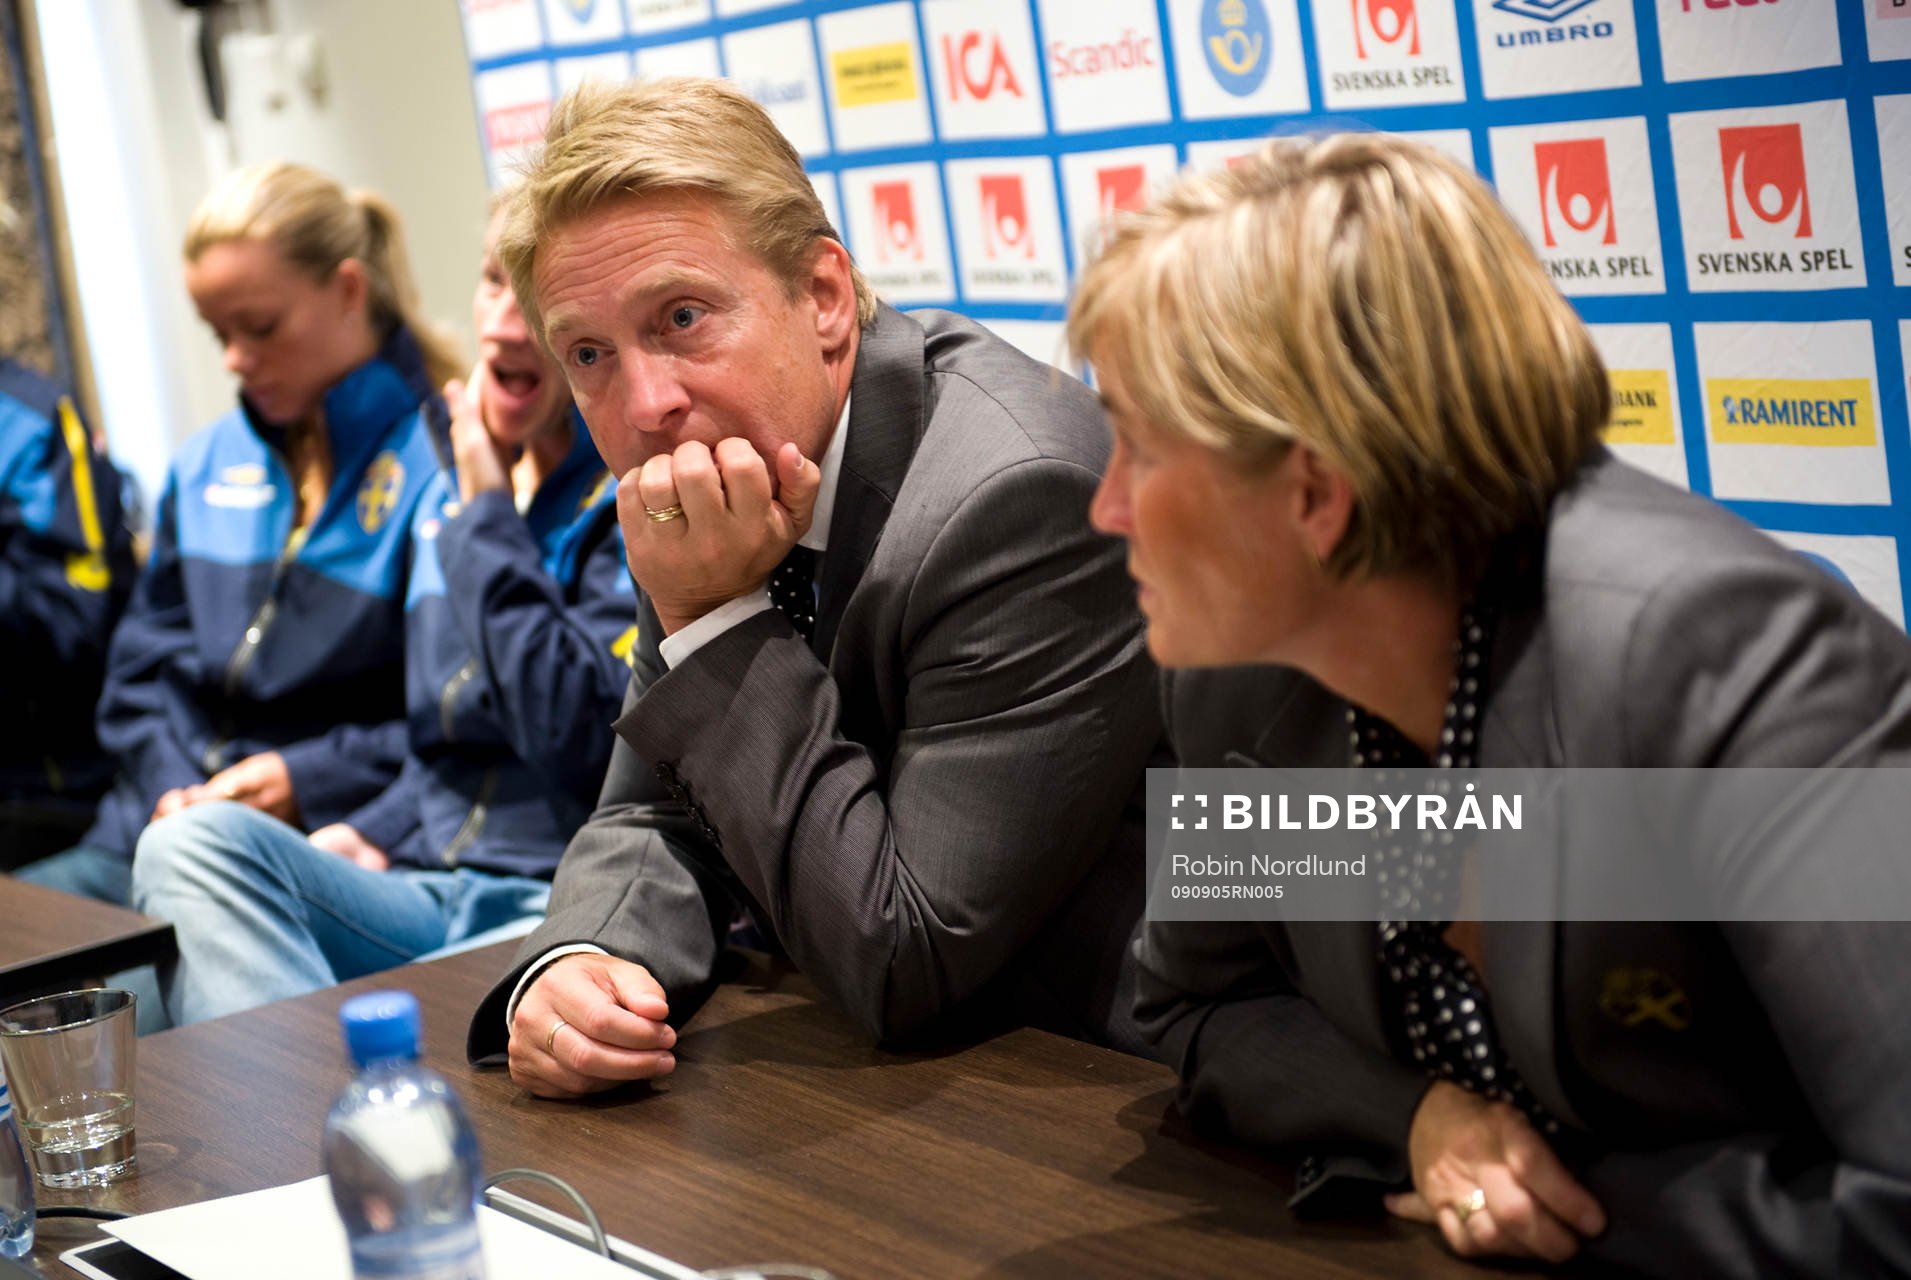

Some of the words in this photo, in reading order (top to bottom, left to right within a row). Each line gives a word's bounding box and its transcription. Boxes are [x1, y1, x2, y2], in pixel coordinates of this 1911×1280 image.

[1496, 21, 1614, 48] UMBRO
[941, 30, 1024, 102] ICA
[1051, 29, 1155, 78] Scandic
[1333, 69, 1409, 91] SVENSKA
[1413, 66, 1454, 87] SPEL
[1608, 255, 1653, 276] SPEL
[1698, 252, 1793, 274] SVENSKA
[1801, 249, 1853, 271] SPEL
[1741, 398, 1857, 427] RAMIRENT
